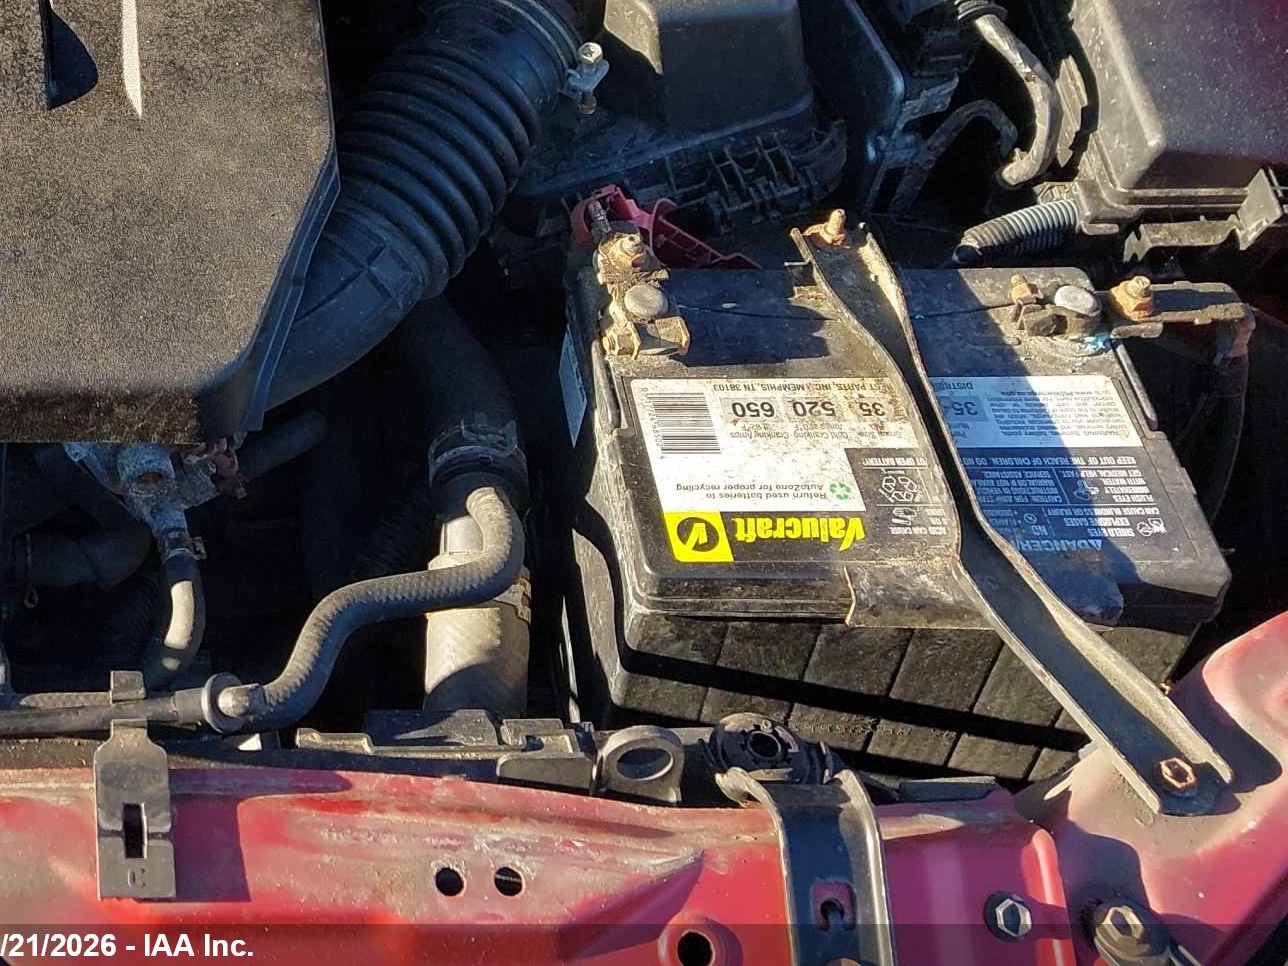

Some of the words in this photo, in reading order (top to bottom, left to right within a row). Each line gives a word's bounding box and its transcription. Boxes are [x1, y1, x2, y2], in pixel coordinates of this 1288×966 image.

[731, 402, 775, 418] 650
[792, 401, 835, 417] 520
[859, 403, 883, 417] 35
[676, 483, 720, 491] recycling
[724, 483, 755, 491] proper
[718, 492, 762, 500] batteries
[766, 492, 789, 500] used
[793, 492, 826, 500] Return
[732, 516, 865, 551] Valucraft
